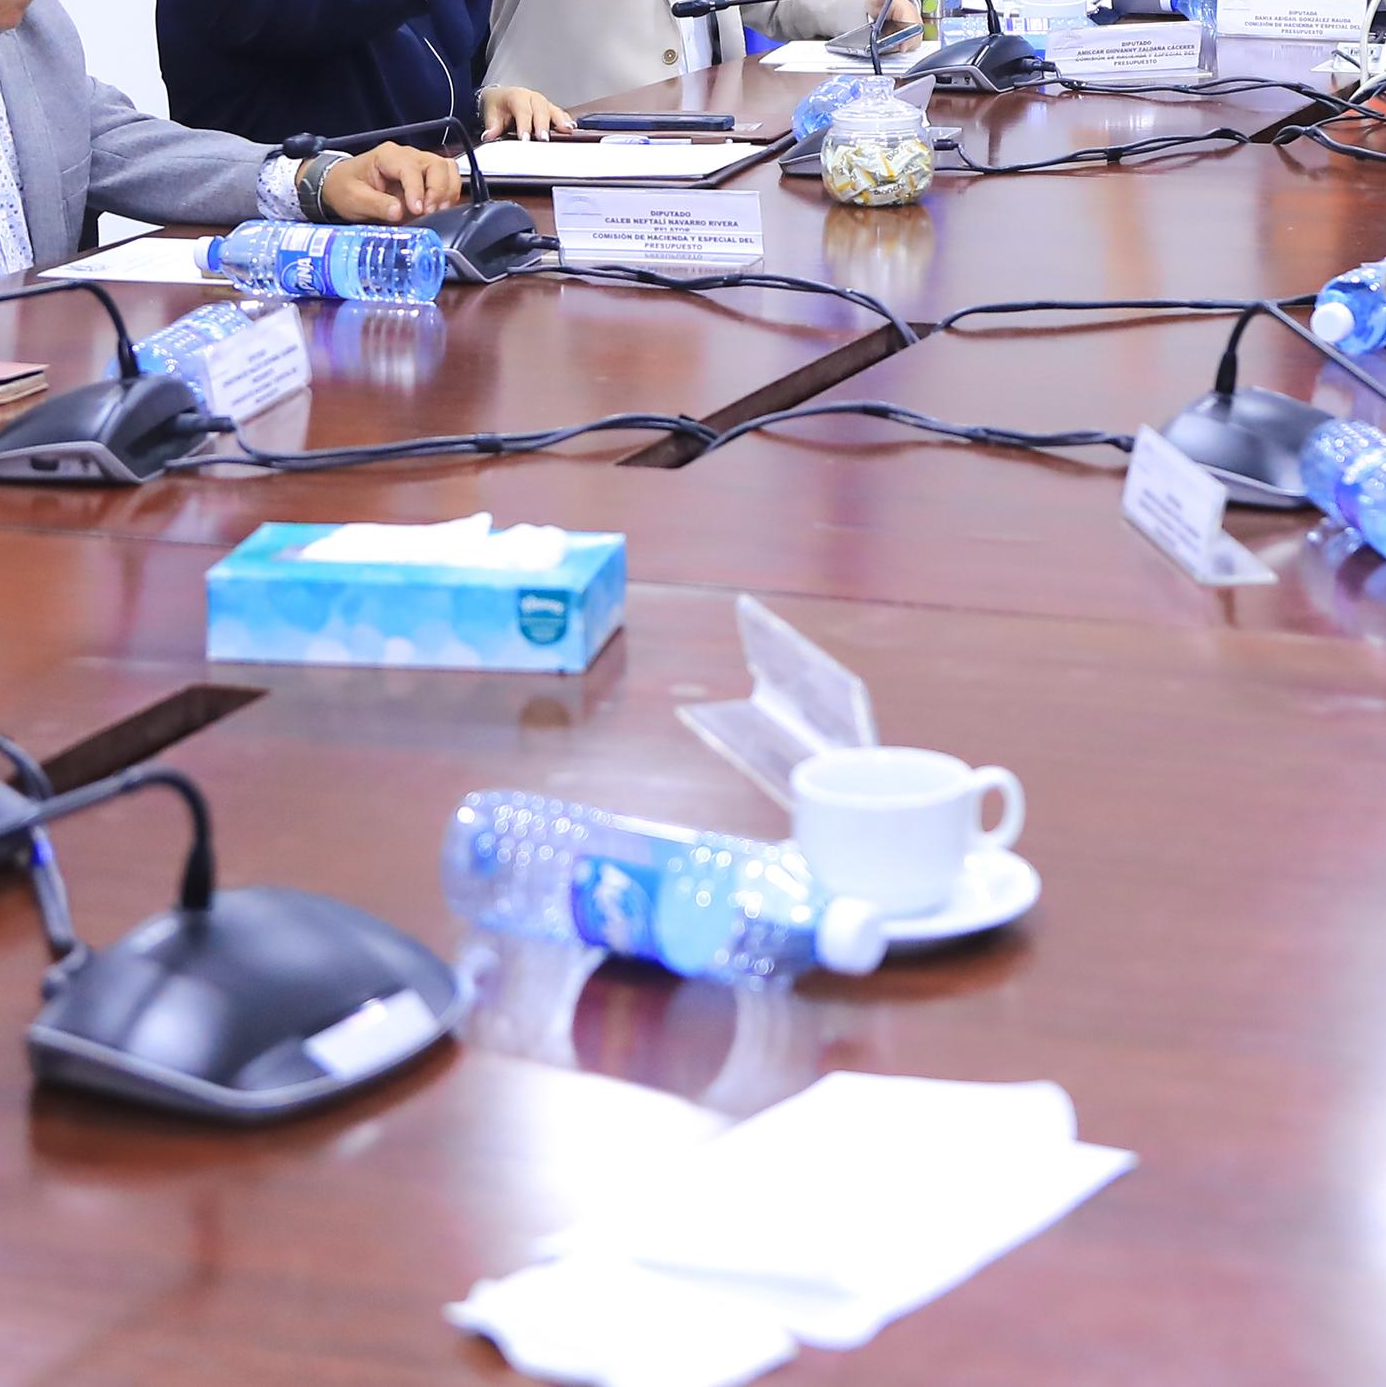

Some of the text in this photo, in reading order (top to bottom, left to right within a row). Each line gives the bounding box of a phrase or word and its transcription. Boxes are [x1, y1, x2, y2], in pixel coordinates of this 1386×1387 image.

[650, 210, 691, 218] DIPUTADO
[633, 217, 666, 225] NEFTALÍ
[668, 219, 707, 227] NAVARRO
[592, 232, 633, 240] COMISIÓN
[634, 233, 645, 241] DE
[644, 242, 703, 250] PRESUPUESTO
